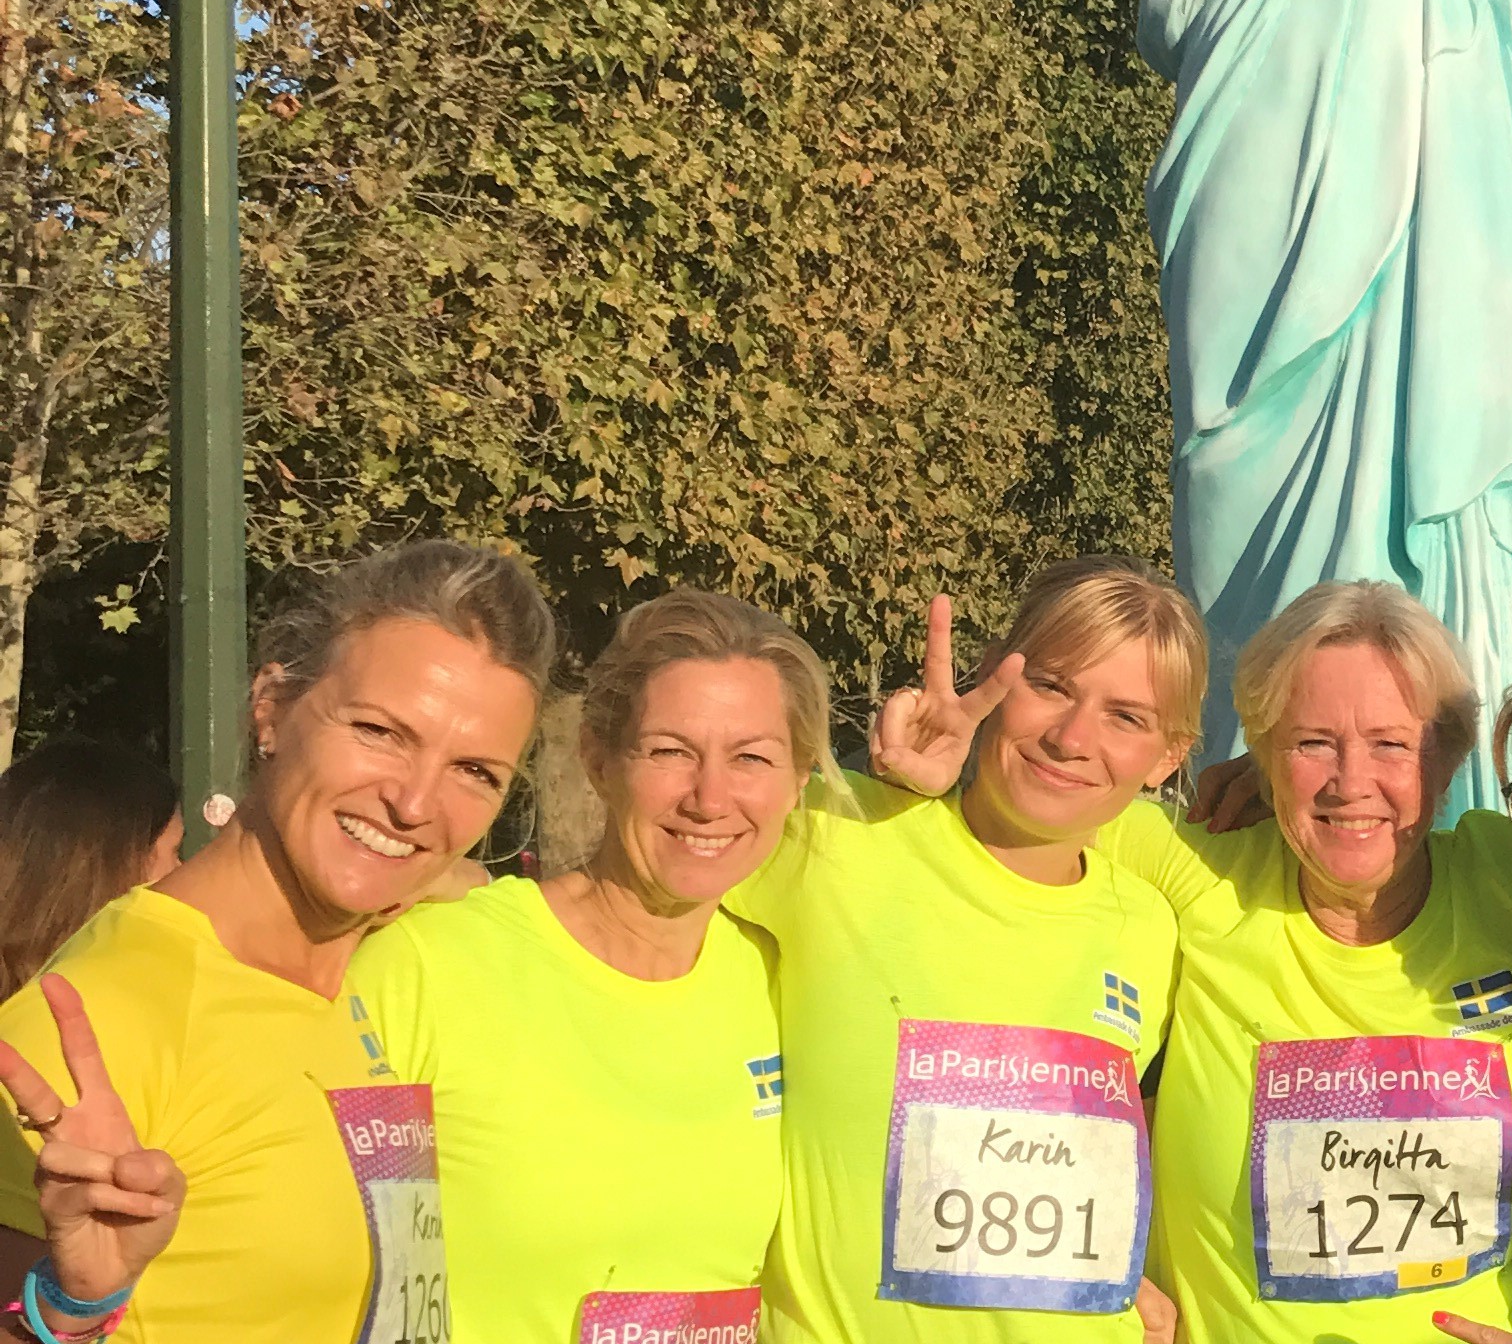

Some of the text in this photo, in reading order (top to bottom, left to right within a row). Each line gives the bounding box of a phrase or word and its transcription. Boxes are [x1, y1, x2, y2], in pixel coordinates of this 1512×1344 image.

[977, 1119, 1076, 1168] Karin
[1320, 1130, 1452, 1192] Birgitta
[932, 1187, 1102, 1262] 9891
[1308, 1190, 1470, 1261] 1274
[1429, 1262, 1443, 1279] 6
